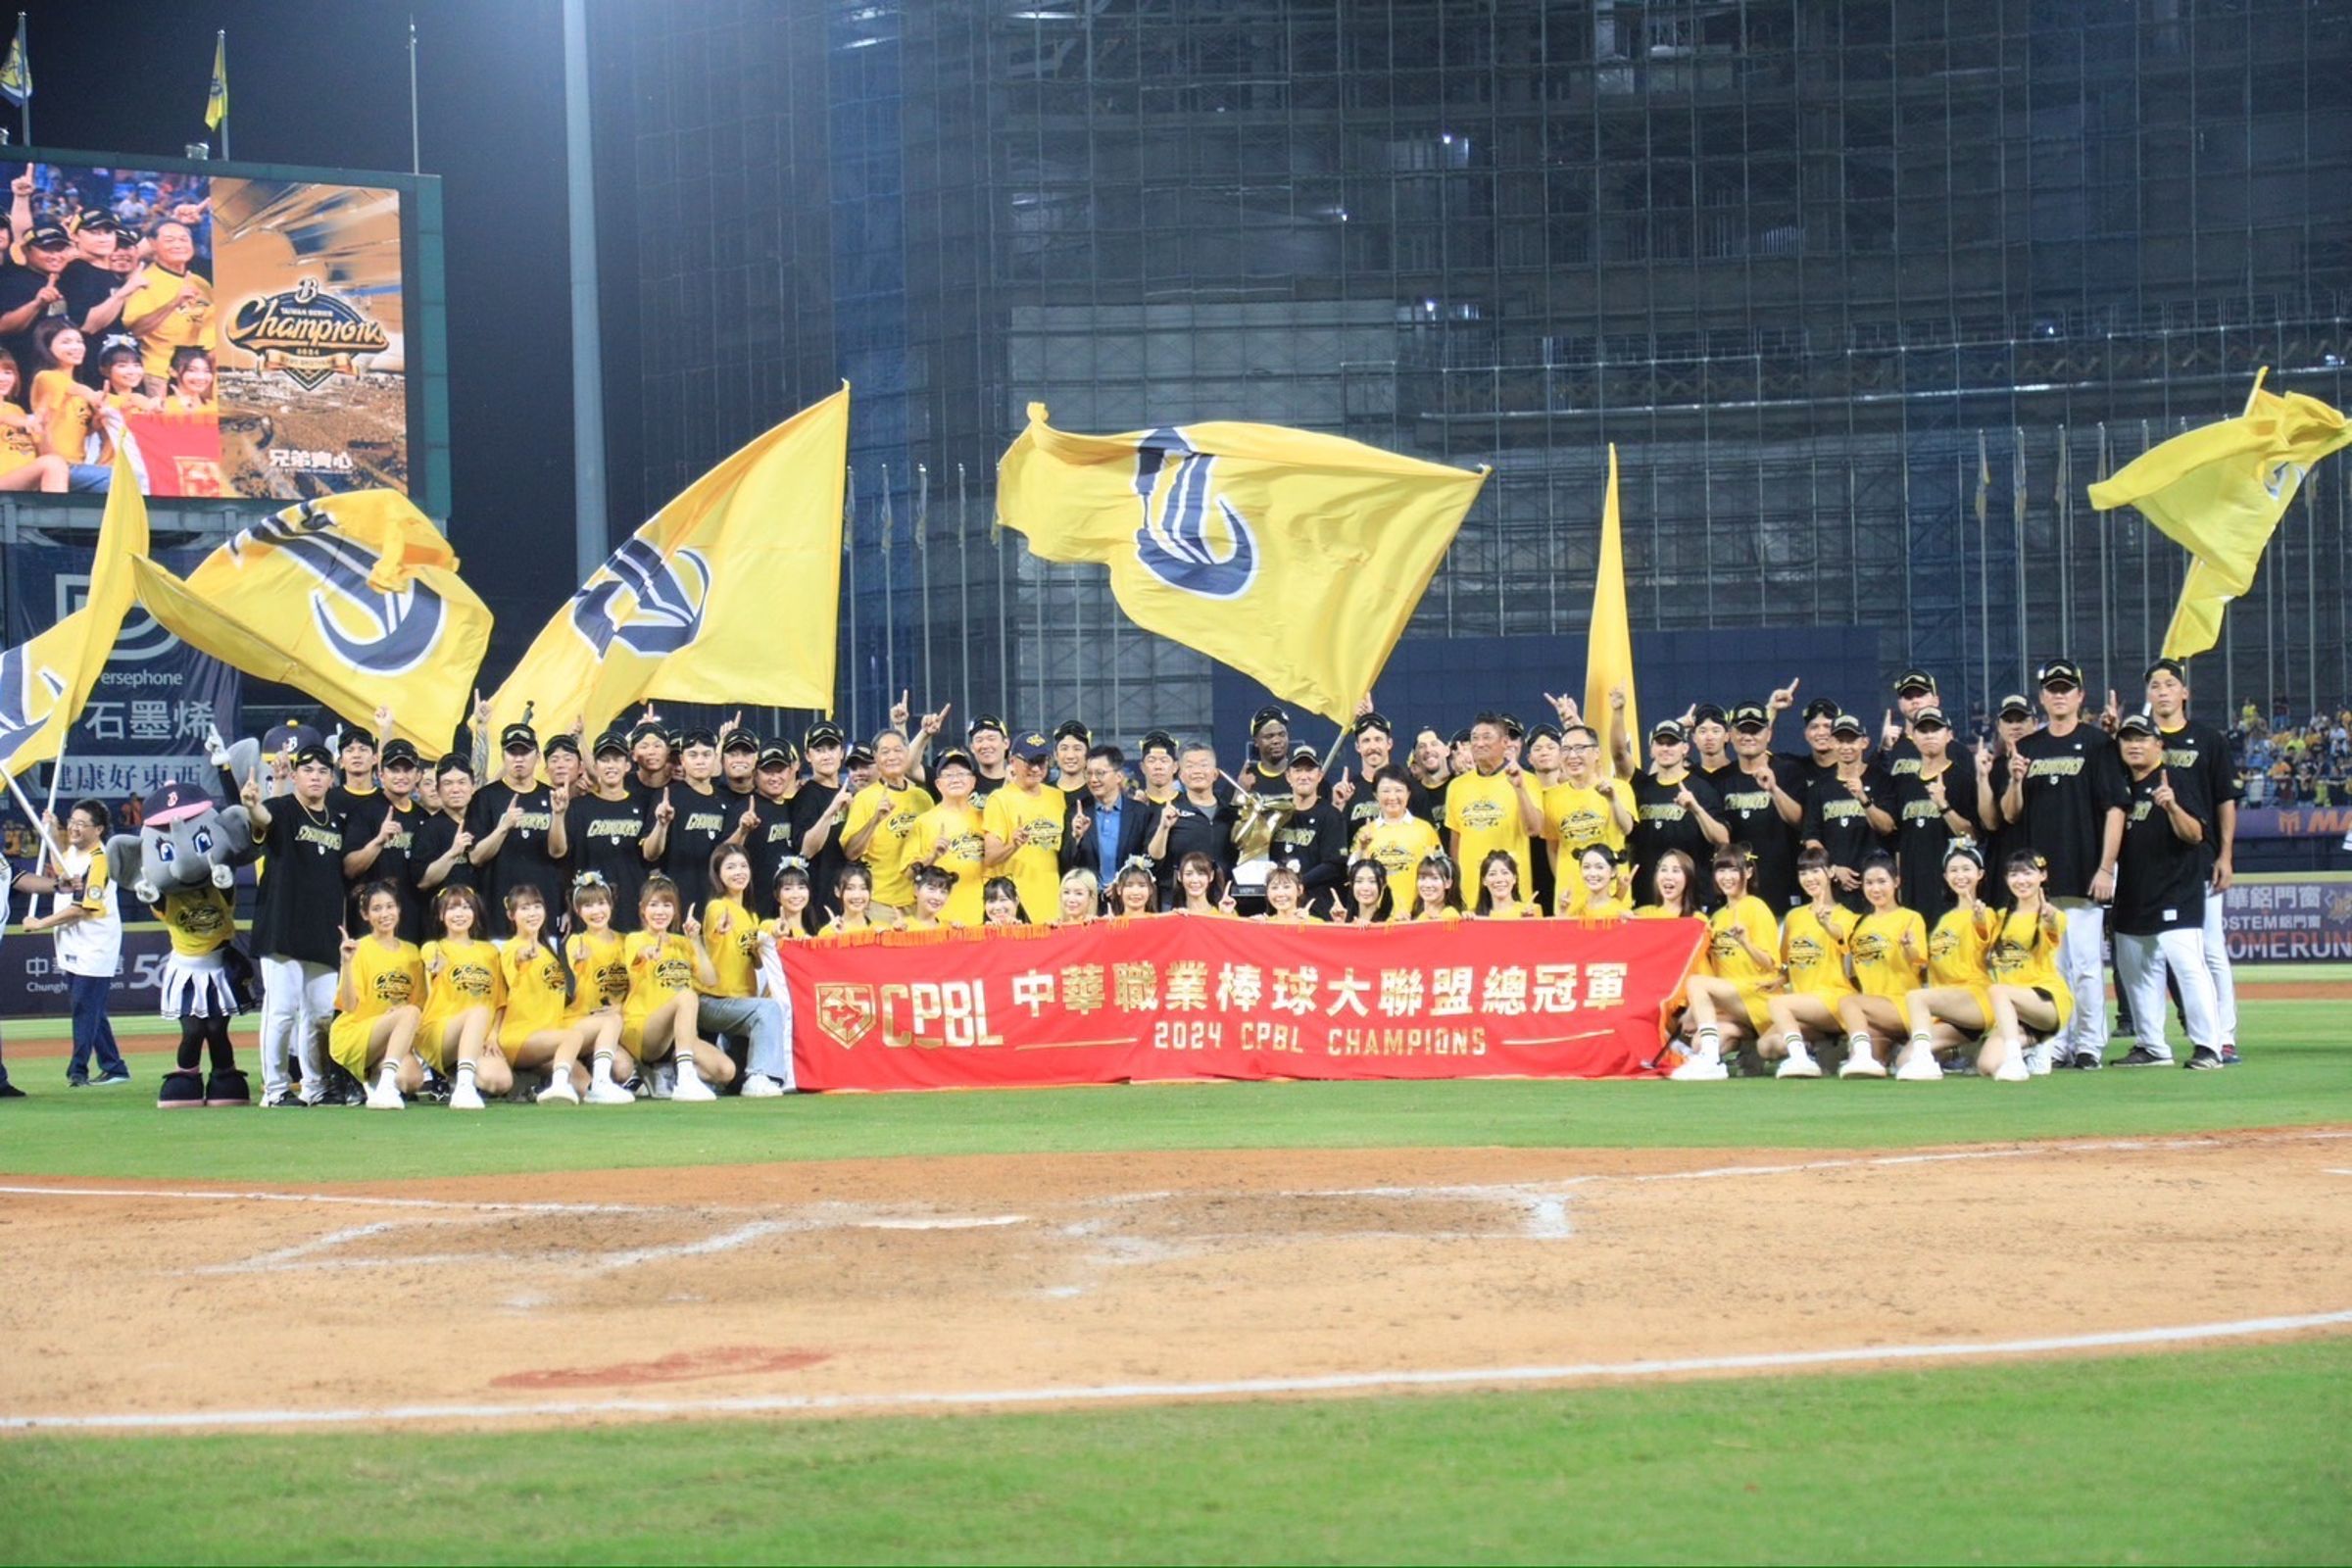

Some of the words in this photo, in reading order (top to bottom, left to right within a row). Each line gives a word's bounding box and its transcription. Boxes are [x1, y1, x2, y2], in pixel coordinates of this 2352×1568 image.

[226, 295, 388, 350] Champions
[99, 668, 183, 689] ersephone
[84, 700, 215, 741] 石墨烯
[2227, 932, 2352, 959] OMERUN
[1012, 960, 1628, 1018] 中華職業棒球大聯盟總冠軍
[880, 978, 1004, 1049] CPBL
[1153, 1021, 1223, 1051] 2024
[1240, 1022, 1304, 1054] CPBL
[1327, 1026, 1487, 1056] CHAMPIONS
